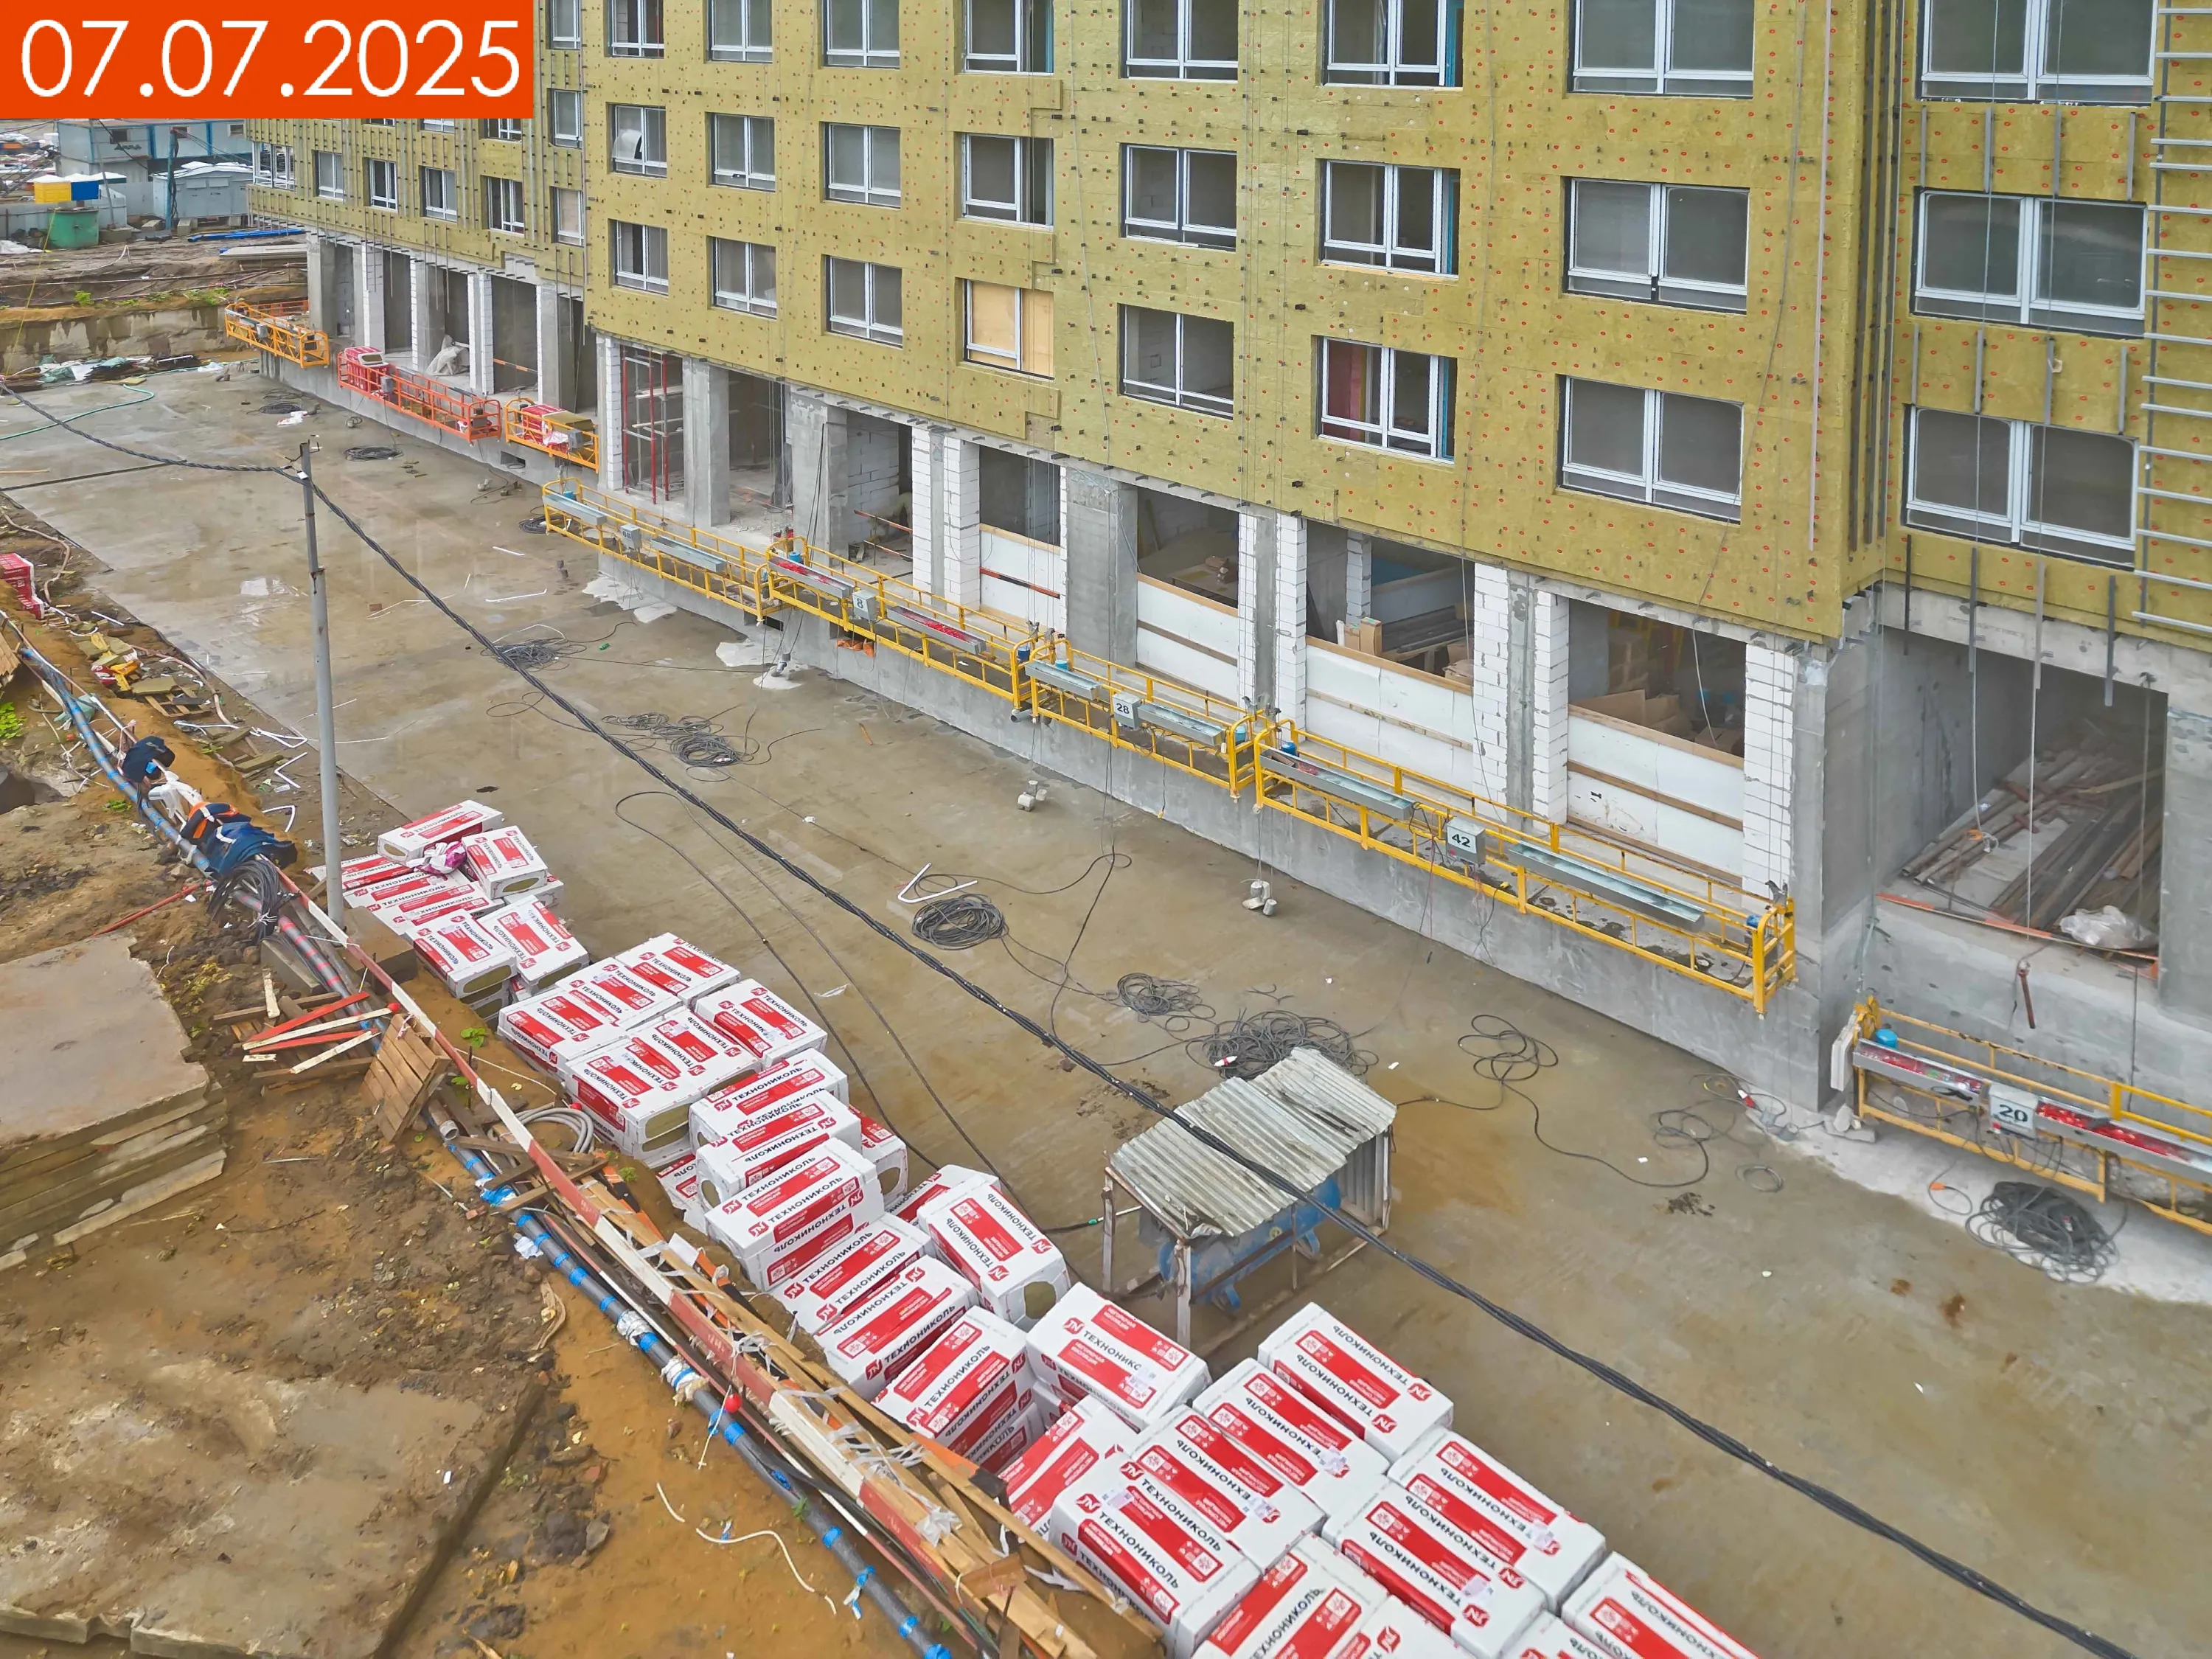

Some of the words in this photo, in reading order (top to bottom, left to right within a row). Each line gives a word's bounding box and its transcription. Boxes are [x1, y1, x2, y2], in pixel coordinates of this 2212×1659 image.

[856, 597, 864, 609] 8
[1116, 703, 1130, 714] 28
[1451, 833, 1471, 848] 42
[382, 885, 446, 906] ТЕХНОНИКОЛЬ
[427, 934, 460, 964] ТЕХНОНИКОЛЬ
[462, 922, 493, 950] ТЕХНОНИКОЛЬ
[493, 925, 526, 961] ТЕХНОНИКОЛЬ
[614, 970, 656, 997] ТЕХНОНИКОЛЬ
[652, 958, 693, 982] ТЕХНОНИКОЛЬ
[582, 986, 623, 1015] ТЕХНОНИКОЛЬ
[764, 994, 808, 1028] ТЕХНОНИКОЛЬ
[536, 1007, 578, 1035] ТЕХНОНИКОЛЬ
[687, 1017, 728, 1050] ТЕХНОНИКОЛЬ
[651, 1034, 693, 1068] ТЕХНОНИКОЛЬ
[583, 1068, 627, 1101] ТЕХНОНИКОЛЬ
[732, 1067, 803, 1102] ТЕХНОНИКОЛЬ
[727, 1102, 802, 1137] ТЕХНОНИКОЛЬ
[1999, 1104, 2028, 1122] 20
[745, 1127, 818, 1162] ТЕХНОНИКОЛЬ
[741, 1156, 817, 1201] ТЕХНОНИКОЛЬ
[768, 1177, 844, 1223] ТЕХНОНИКОЛЬ
[987, 1193, 1037, 1242] ТЕХНОНИКОЛЬ
[773, 1204, 847, 1253] ТЕХНОНИКОЛЬ
[946, 1218, 995, 1268] ТЕХНОНИКОЛЬ
[802, 1231, 874, 1284] ТЕХНОНИКОЛЬ
[835, 1251, 907, 1305] ТЕХНОНИКОЛЬ
[833, 1281, 908, 1335] ТЕХНОНИКОЛЬ
[884, 1305, 956, 1363] ТЕХНОНИКОЛЬ
[1333, 1325, 1408, 1386] ТЕХНОНИКОЛЬ
[924, 1345, 991, 1408] ТЕХНОНИКОЛЬ
[1296, 1354, 1373, 1417] ТЕХНОНИКОЛЬ
[945, 1370, 1011, 1438] ТЕХНОНИКОЛЬ
[1245, 1397, 1322, 1459] ЕХНОНИКОЛЬ
[1177, 1440, 1251, 1500] ЕХНОНИКОЛЬ
[1141, 1478, 1222, 1553] ТЕХНОНИКОЛЬ
[1405, 1495, 1497, 1571] ТЕХНОНИКОЛЬ
[1099, 1512, 1179, 1589] ТЕХНОНИКОЛЬ
[1369, 1531, 1462, 1607] ТЕХНОНИКОЛЬ
